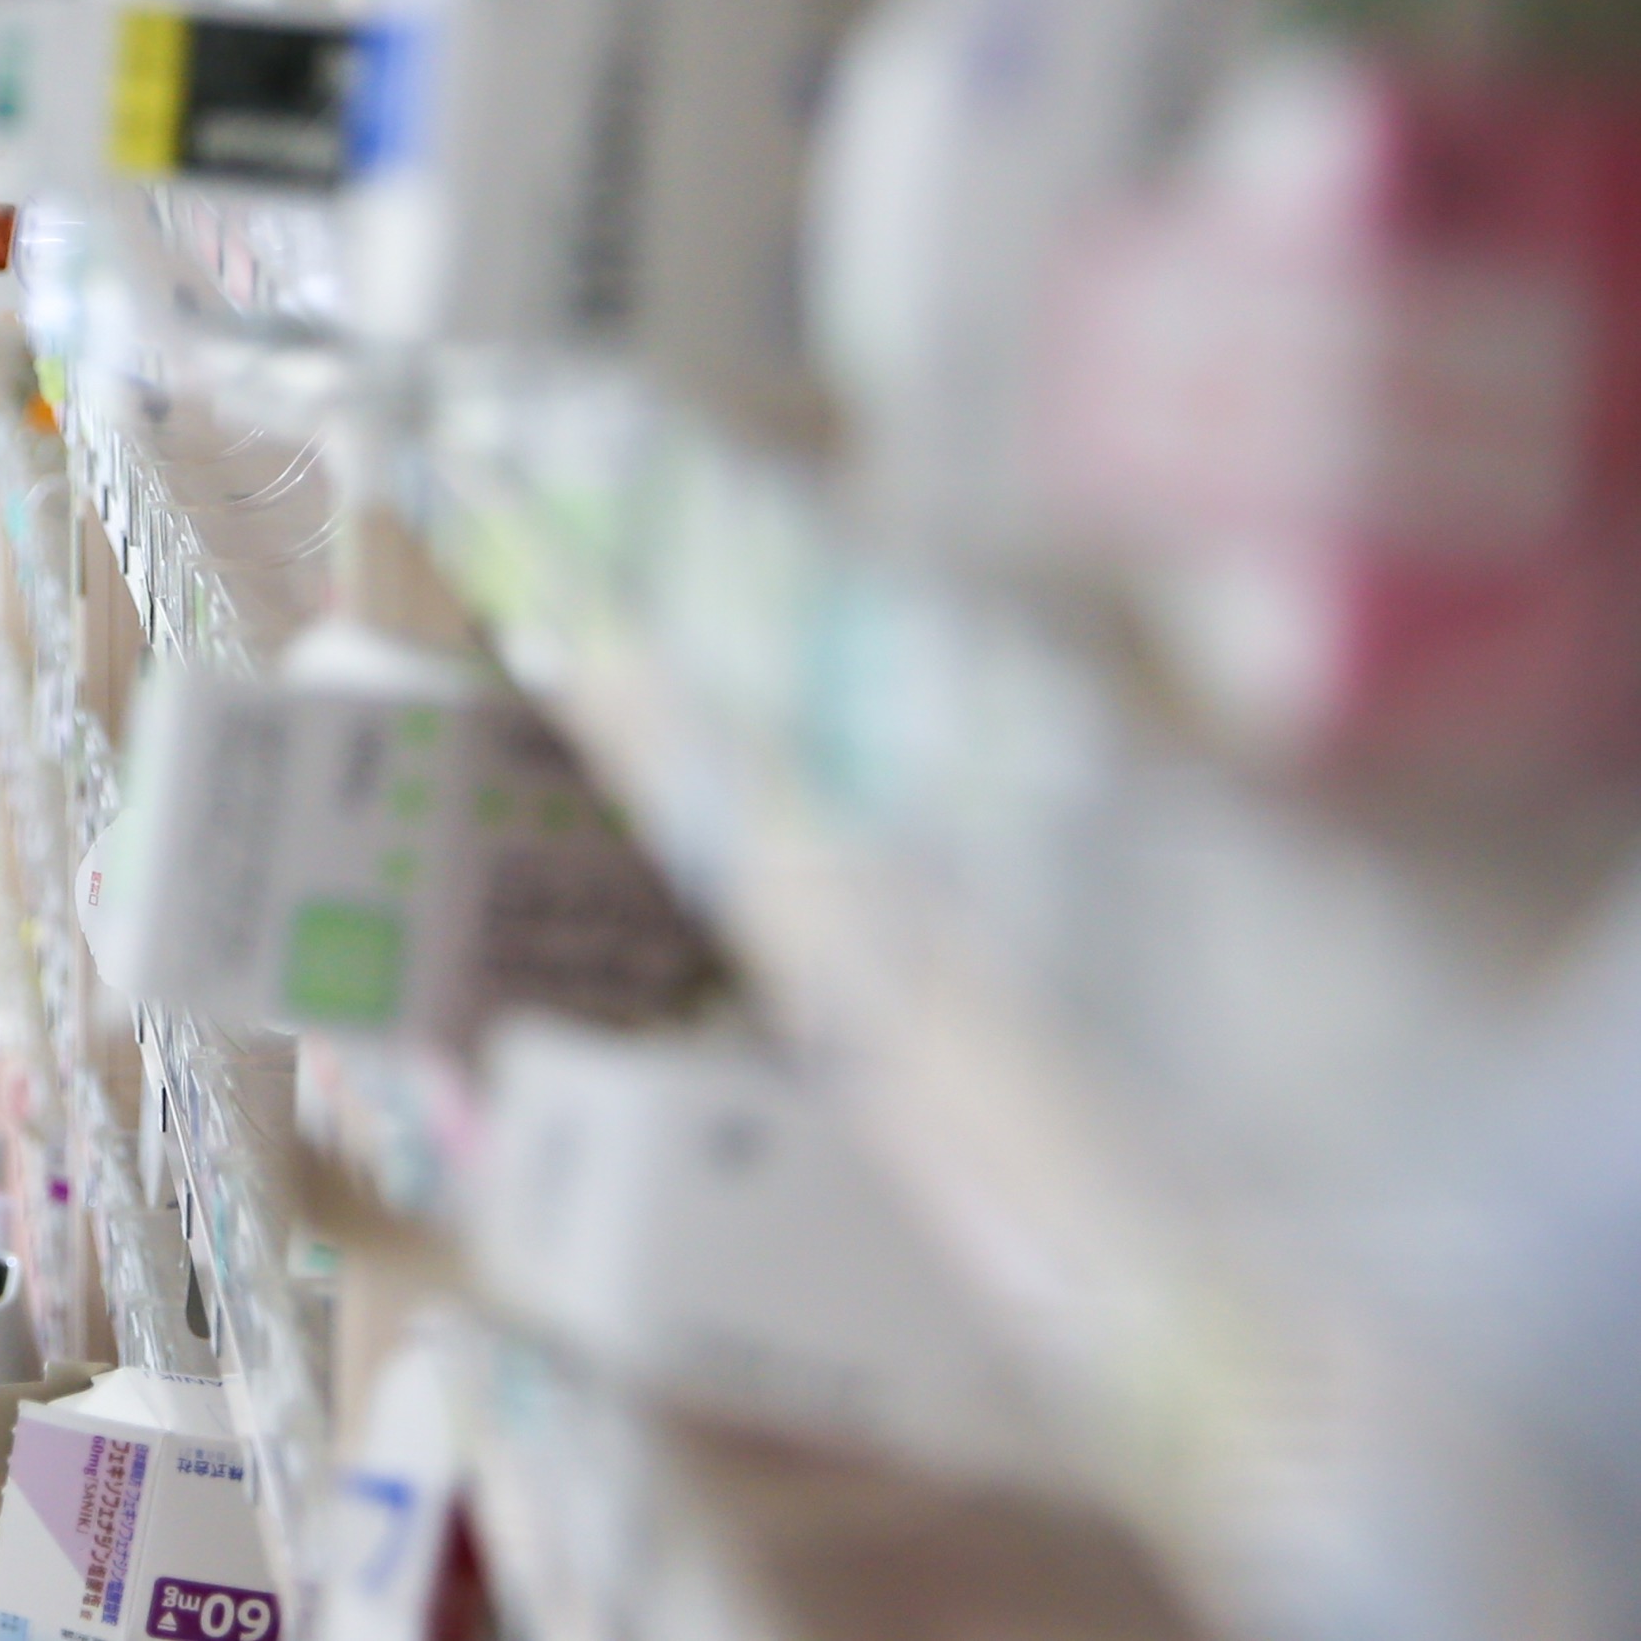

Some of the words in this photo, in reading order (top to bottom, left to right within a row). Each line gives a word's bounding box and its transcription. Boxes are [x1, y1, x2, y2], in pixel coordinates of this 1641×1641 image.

[176, 1457, 244, 1483] 株式会社
[161, 1585, 272, 1641] 60mg
